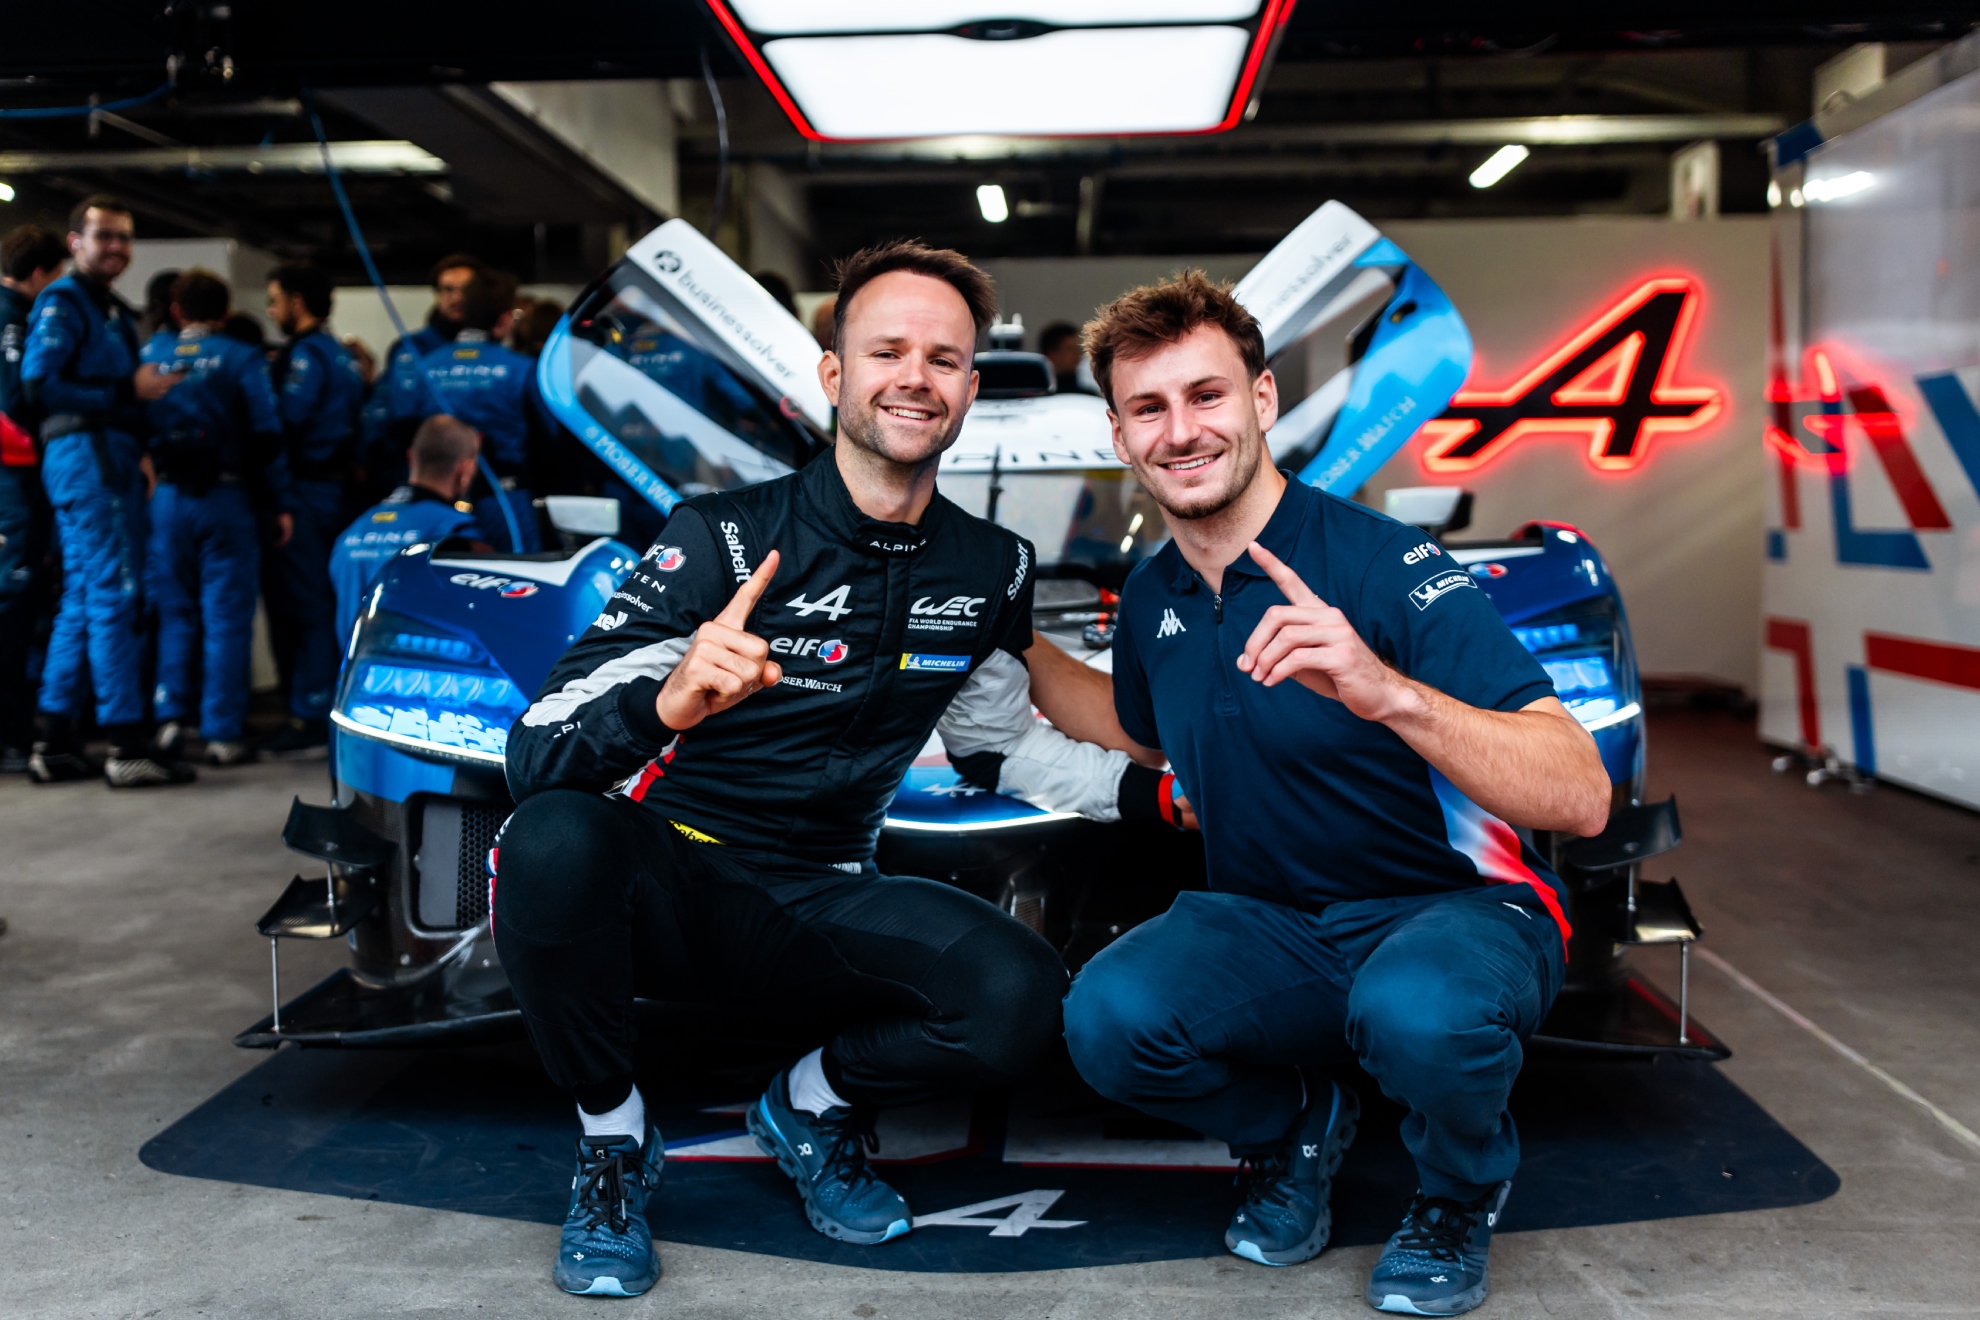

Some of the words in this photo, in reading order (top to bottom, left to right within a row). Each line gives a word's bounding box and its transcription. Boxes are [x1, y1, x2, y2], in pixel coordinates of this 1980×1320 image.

[676, 267, 799, 381] businessolver
[720, 521, 752, 583] Sabelt
[1403, 543, 1429, 565] elf
[450, 573, 512, 590] elf
[910, 596, 986, 617] WEC
[908, 617, 919, 625] FIA
[942, 619, 978, 627] ENDURANCE
[769, 637, 820, 656] elf
[921, 658, 966, 668] MICHELIN
